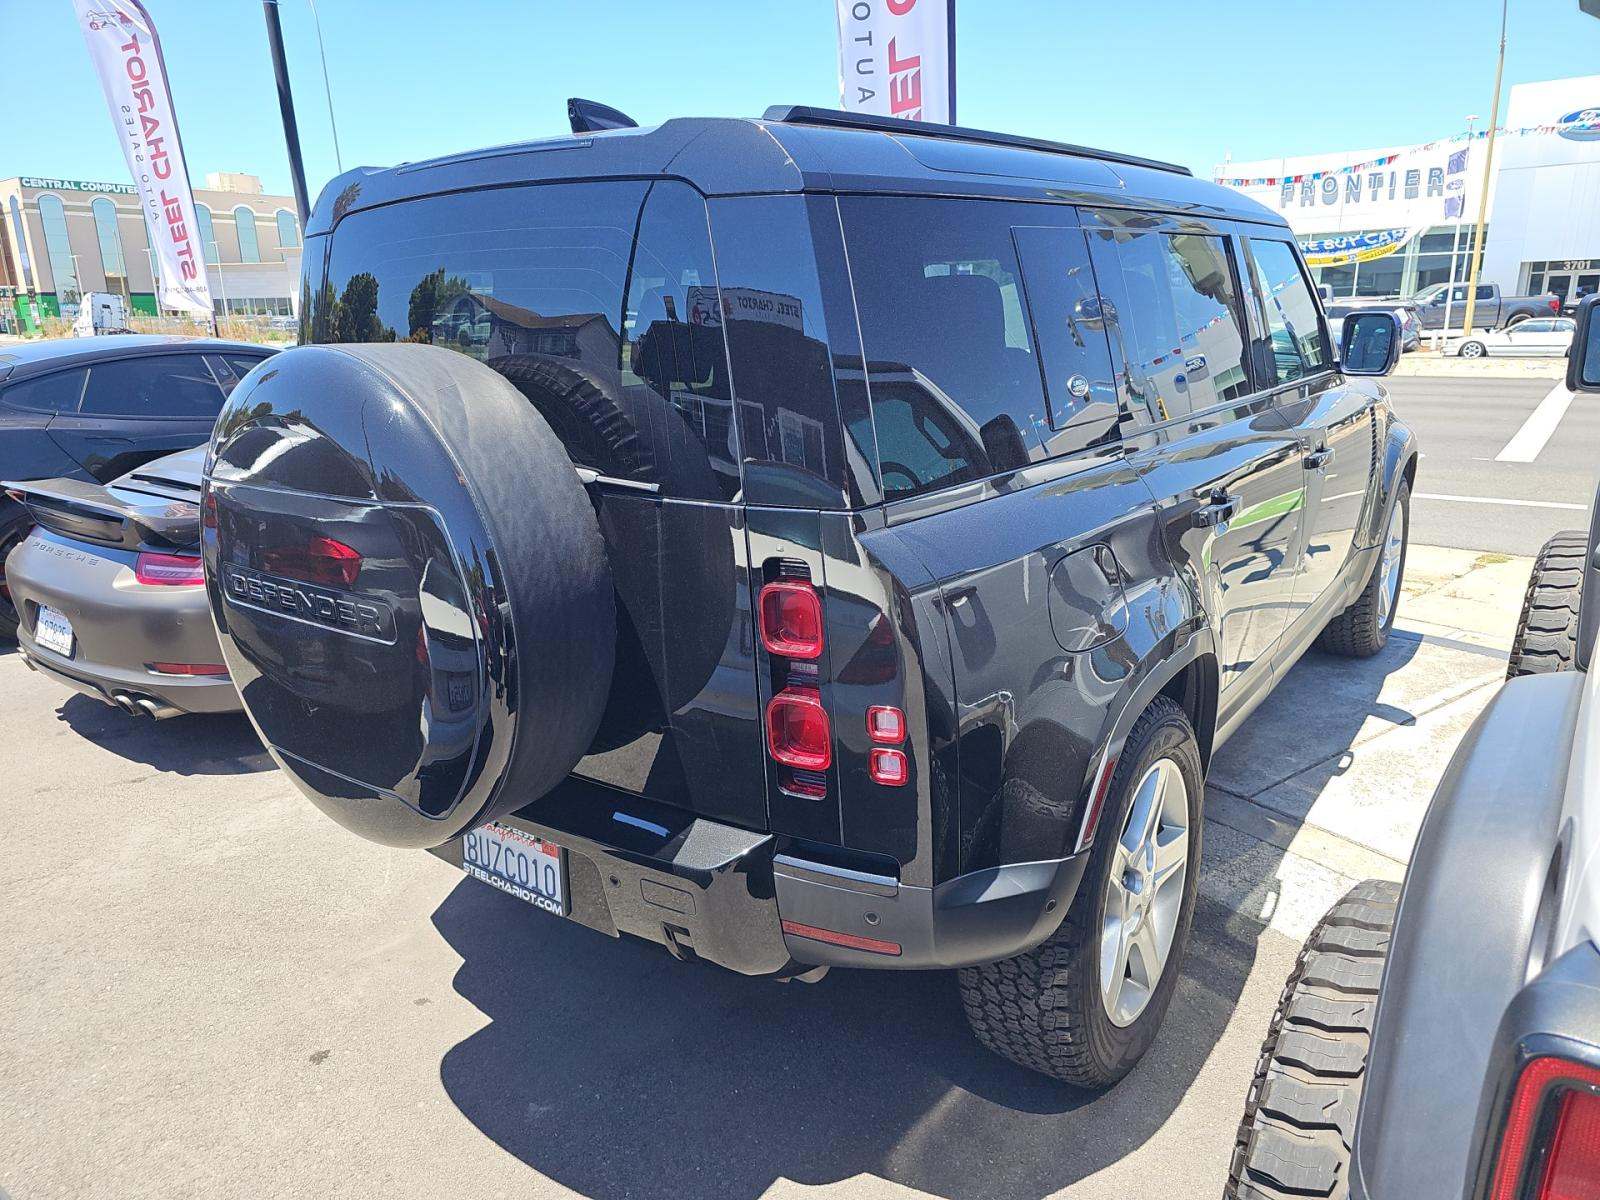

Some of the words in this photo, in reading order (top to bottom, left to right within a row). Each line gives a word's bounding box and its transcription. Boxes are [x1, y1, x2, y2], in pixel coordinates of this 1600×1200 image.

[21, 177, 79, 190] CENTRAL
[1281, 167, 1444, 198] FRONTIER
[1323, 236, 1361, 250] BUY
[1563, 260, 1591, 271] 3701
[33, 541, 99, 566] PORSCHE
[231, 573, 382, 633] DEFENDER
[462, 862, 563, 917] STEELCHARIOT.COM
